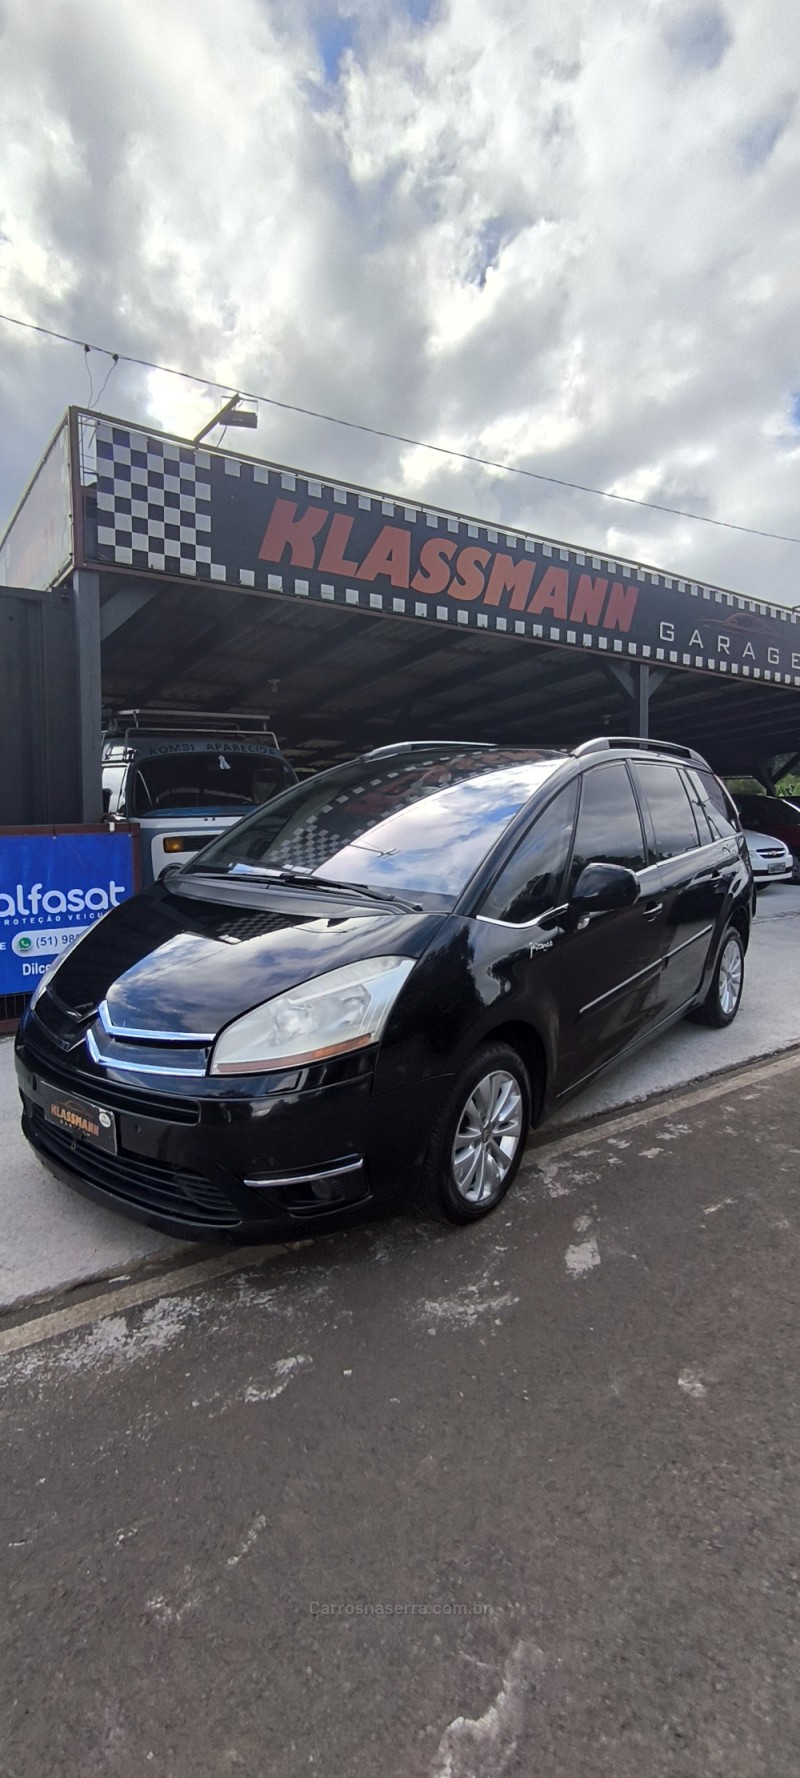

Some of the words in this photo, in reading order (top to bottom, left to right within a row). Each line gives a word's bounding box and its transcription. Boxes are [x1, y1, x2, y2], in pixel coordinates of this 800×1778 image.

[257, 498, 640, 633] KLASSMANN
[659, 621, 800, 670] GARAGE
[149, 743, 195, 755] KOMBI
[206, 742, 276, 755] APARECIDA
[0, 880, 125, 917] alfasat
[0, 914, 61, 926] ROTEÇÃO
[36, 935, 58, 949] (51)
[50, 1103, 100, 1137] KLASSMANN
